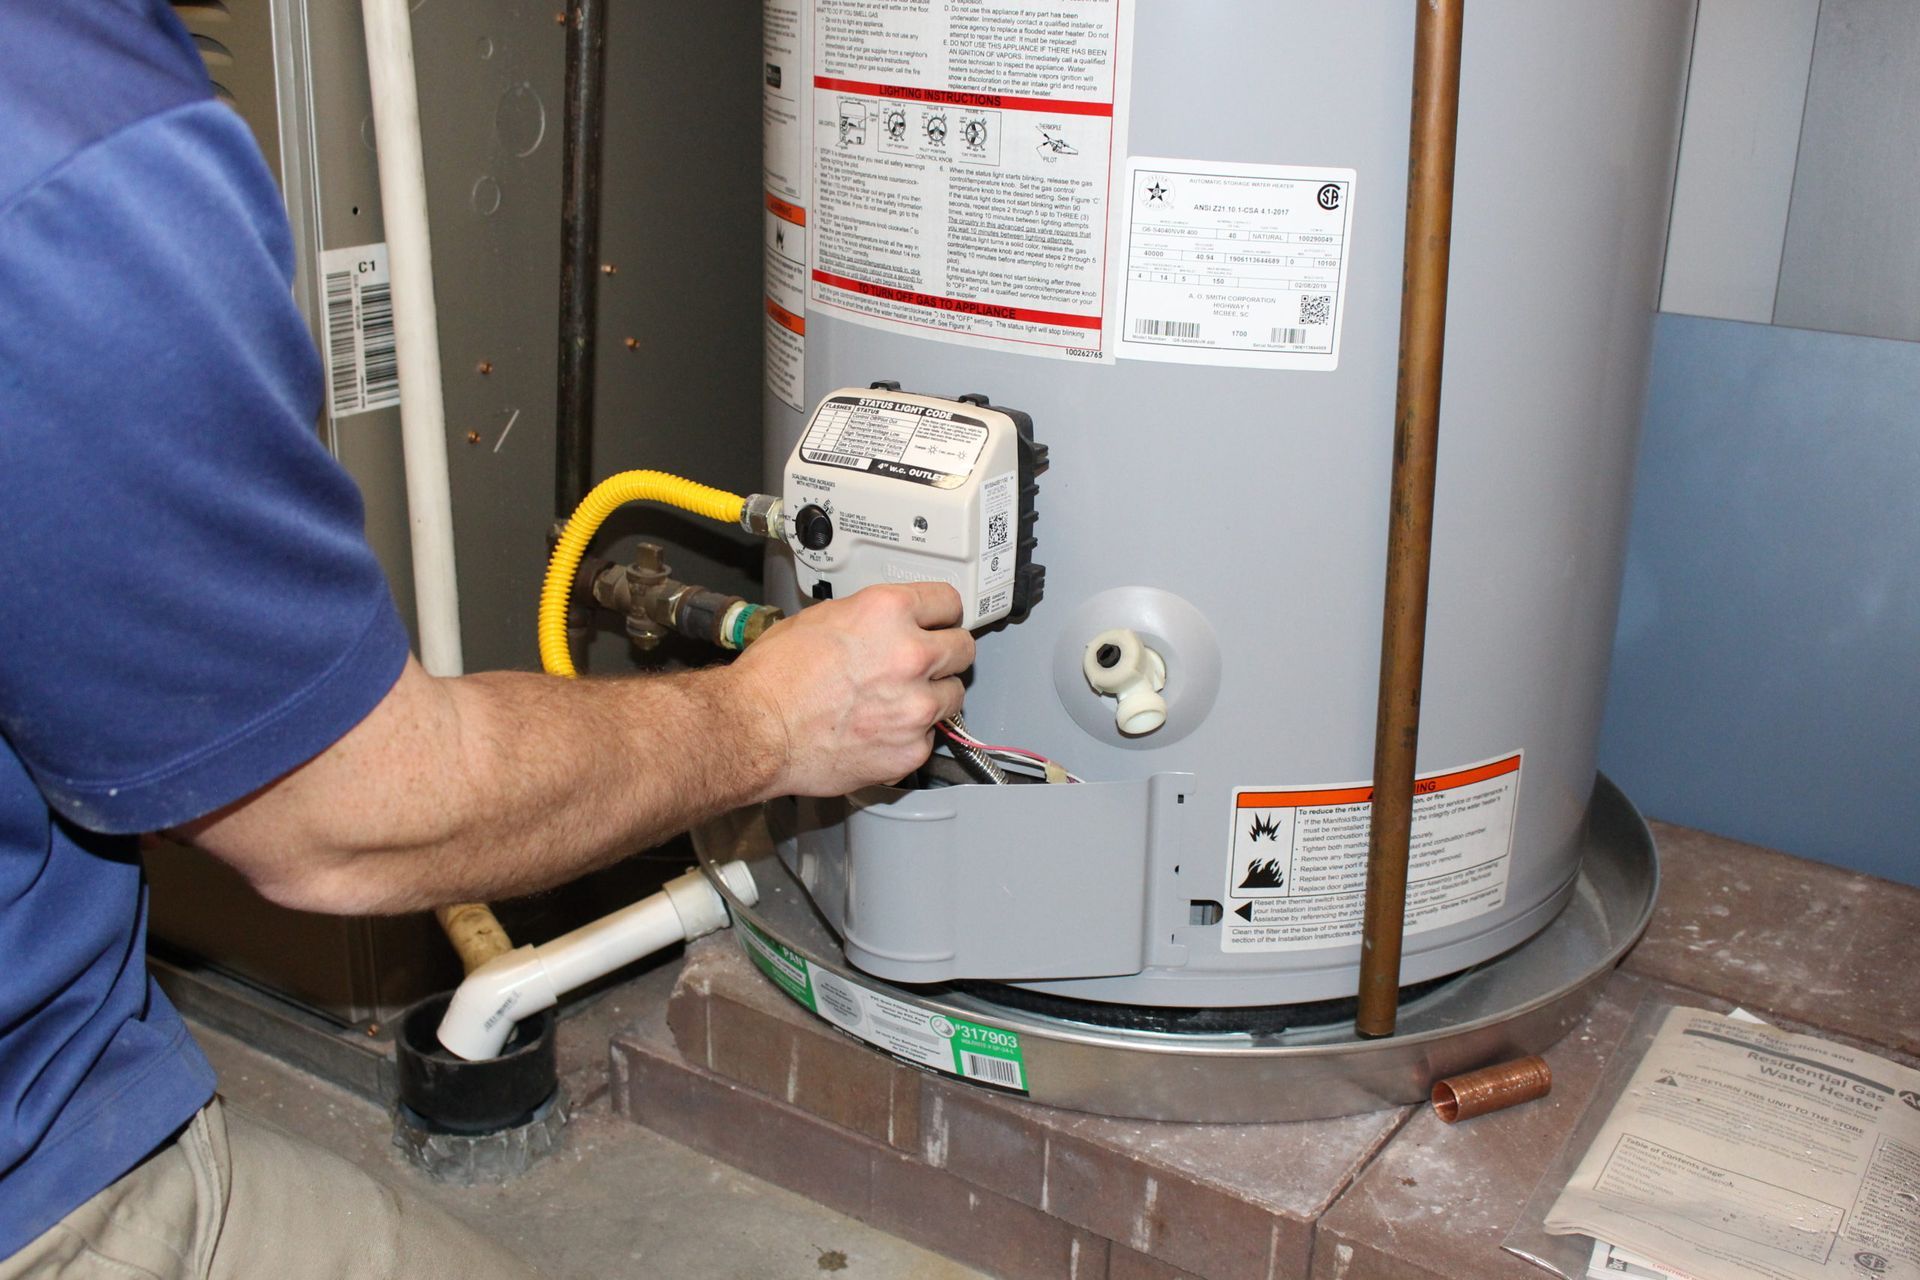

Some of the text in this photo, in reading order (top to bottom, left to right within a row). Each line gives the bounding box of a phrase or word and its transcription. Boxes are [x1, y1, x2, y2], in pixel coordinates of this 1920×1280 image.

[1003, 43, 1038, 51] APPLIANCE
[880, 88, 1000, 106] LIGHTING INSTRUCTIONS
[916, 153, 937, 162] CONTROL
[1318, 184, 1341, 210] CSA
[358, 260, 376, 273] C1
[858, 283, 1016, 319] TO TURN OFF GAS TO APPLIANCE
[1041, 293, 1070, 302] technician
[1065, 349, 1102, 359] 100262765
[859, 399, 953, 420] STATUS LIGHT CODE
[909, 469, 944, 480] OUTLET
[1748, 1052, 1847, 1088] Residential
[1852, 1084, 1887, 1102] Gas
[1760, 1066, 1814, 1088] Water
[1820, 1084, 1882, 1112] Heater
[1678, 1071, 1698, 1080] NOT
[1702, 1075, 1740, 1092] RETURN
[1744, 1087, 1765, 1099] THIS
[1768, 1097, 1792, 1110] UNIT
[1795, 1106, 1808, 1114] TO
[1812, 1111, 1832, 1122] THE
[1832, 1119, 1864, 1134] STORE
[1625, 1137, 1648, 1149] Table
[1662, 1151, 1699, 1170] Contents
[1702, 1166, 1725, 1177] Page
